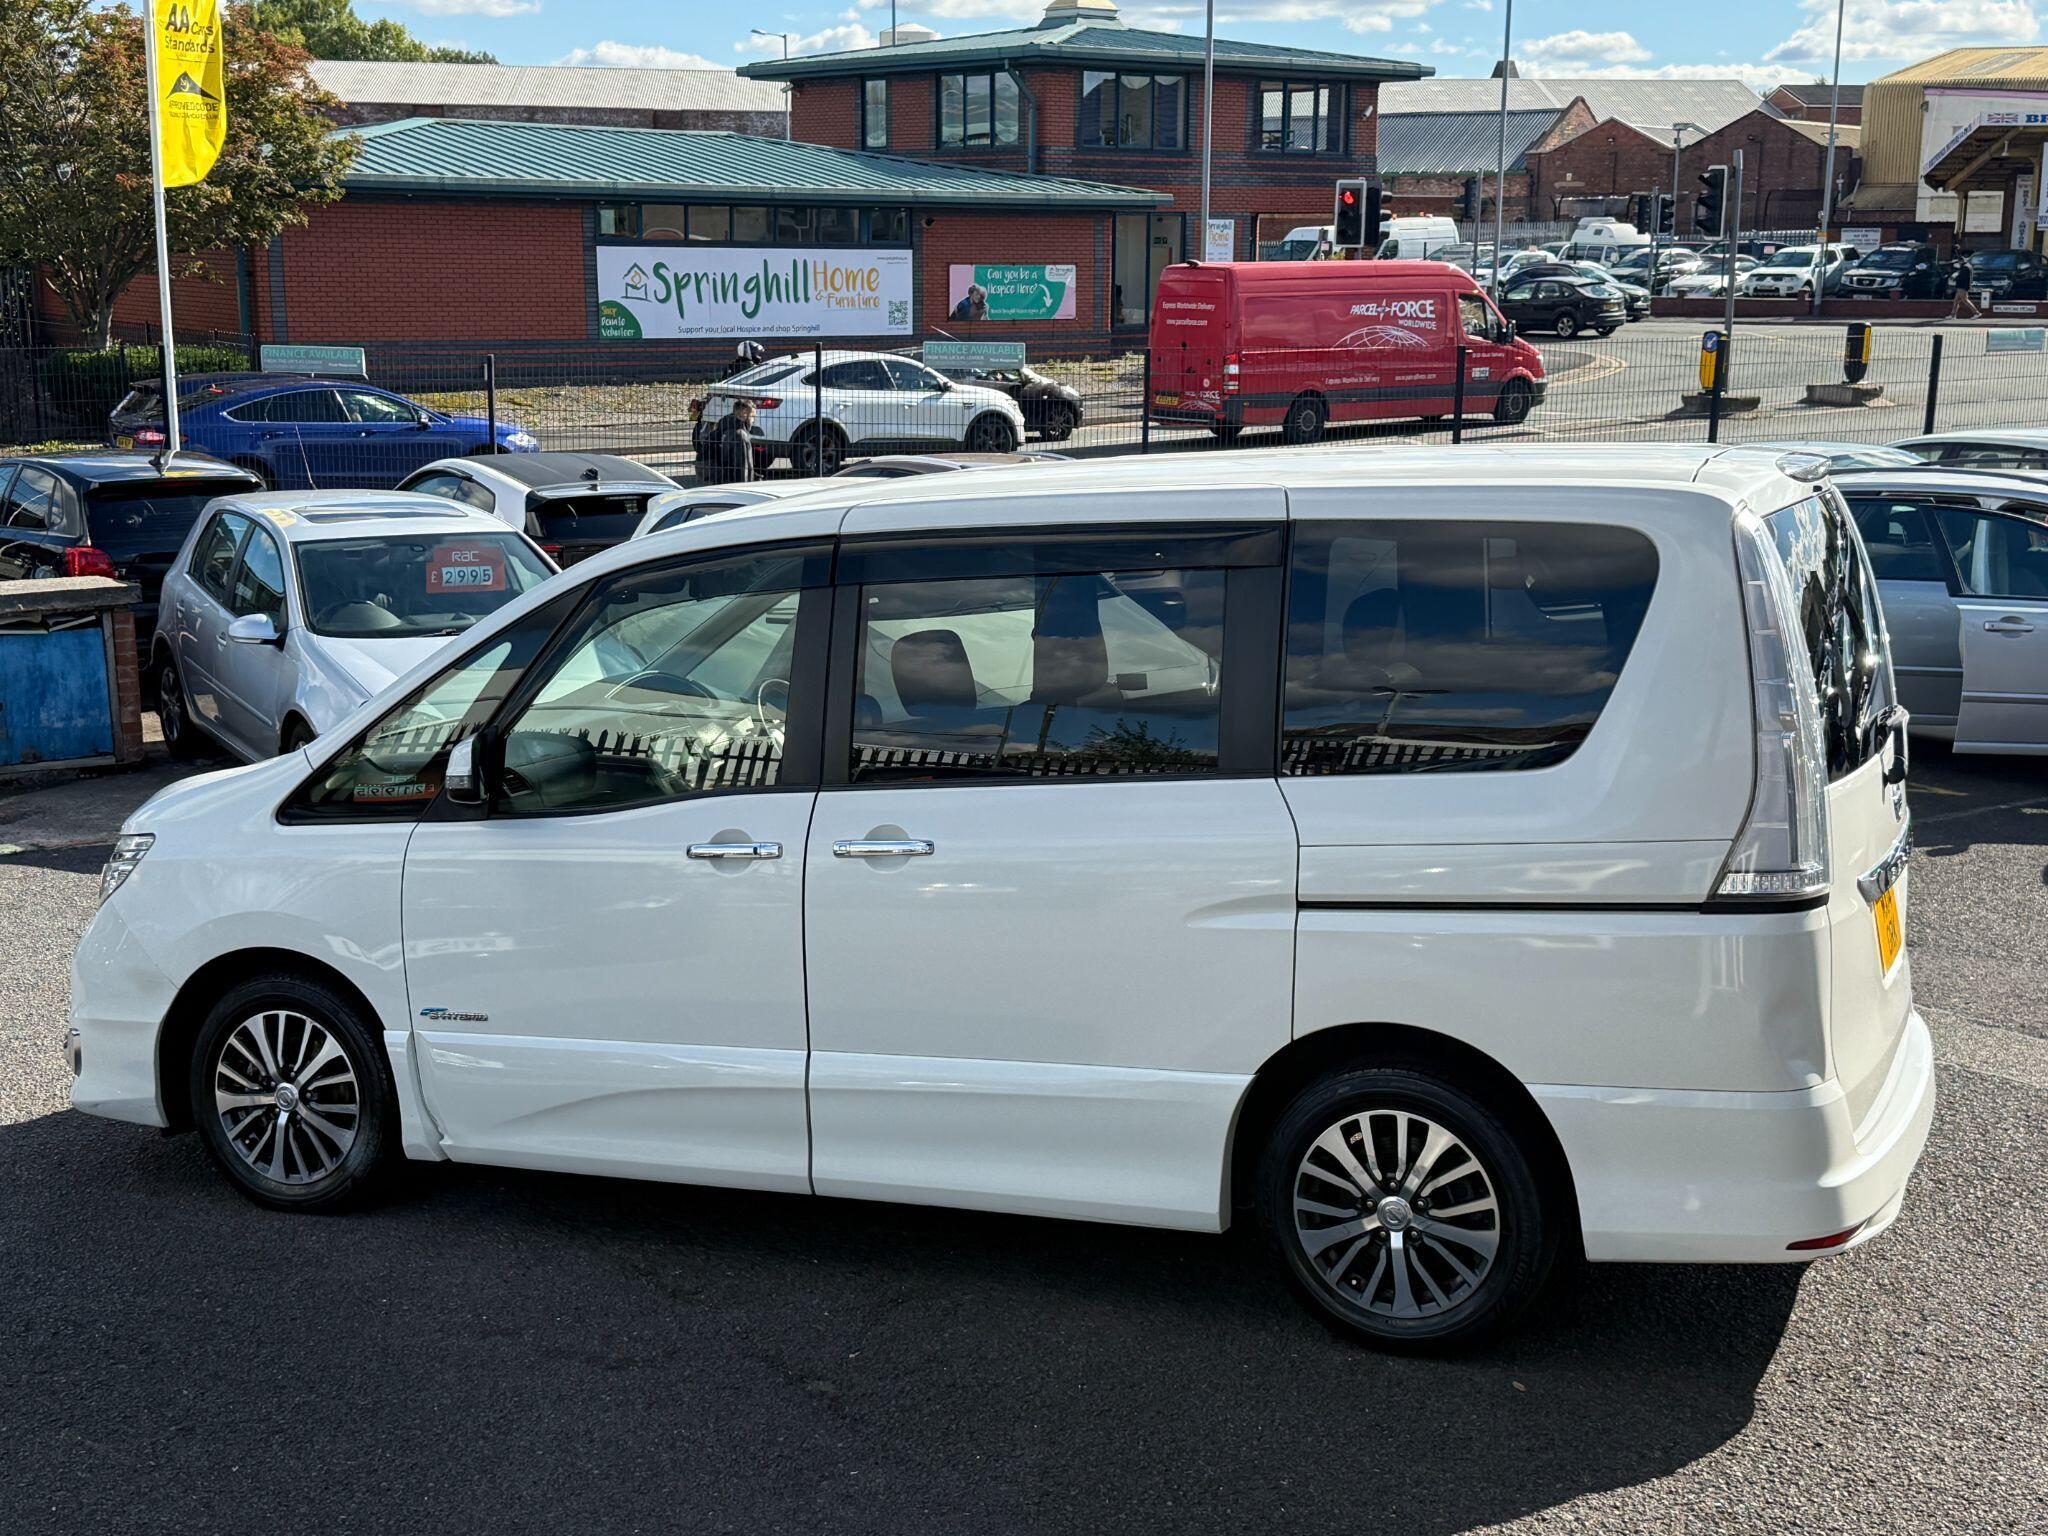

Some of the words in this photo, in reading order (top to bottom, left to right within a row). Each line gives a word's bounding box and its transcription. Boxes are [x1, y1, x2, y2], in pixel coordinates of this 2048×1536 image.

[165, 3, 190, 34] AA
[191, 21, 214, 36] Cars
[165, 35, 215, 54] Standards
[1004, 270, 1019, 284] you
[652, 258, 811, 320] Springhill
[813, 260, 880, 292] Home
[815, 289, 825, 301] &
[827, 292, 881, 309] Furniture
[1350, 304, 1378, 316] PARCEL
[1390, 300, 1436, 319] FORCE
[677, 325, 703, 335] Support
[705, 326, 720, 335] your
[720, 325, 736, 333] local
[737, 325, 761, 334] Hospice
[762, 324, 774, 333] and
[775, 324, 790, 334] shop
[791, 323, 820, 333] Springhill
[1398, 319, 1437, 330] WORLDWIDE
[601, 327, 635, 338] Volunteer
[263, 348, 306, 359] FINANCE
[309, 348, 361, 360] AVAILABLE
[926, 345, 968, 354] FINANCE
[970, 345, 1023, 355] AVAILABLE
[444, 568, 491, 584] 2995
